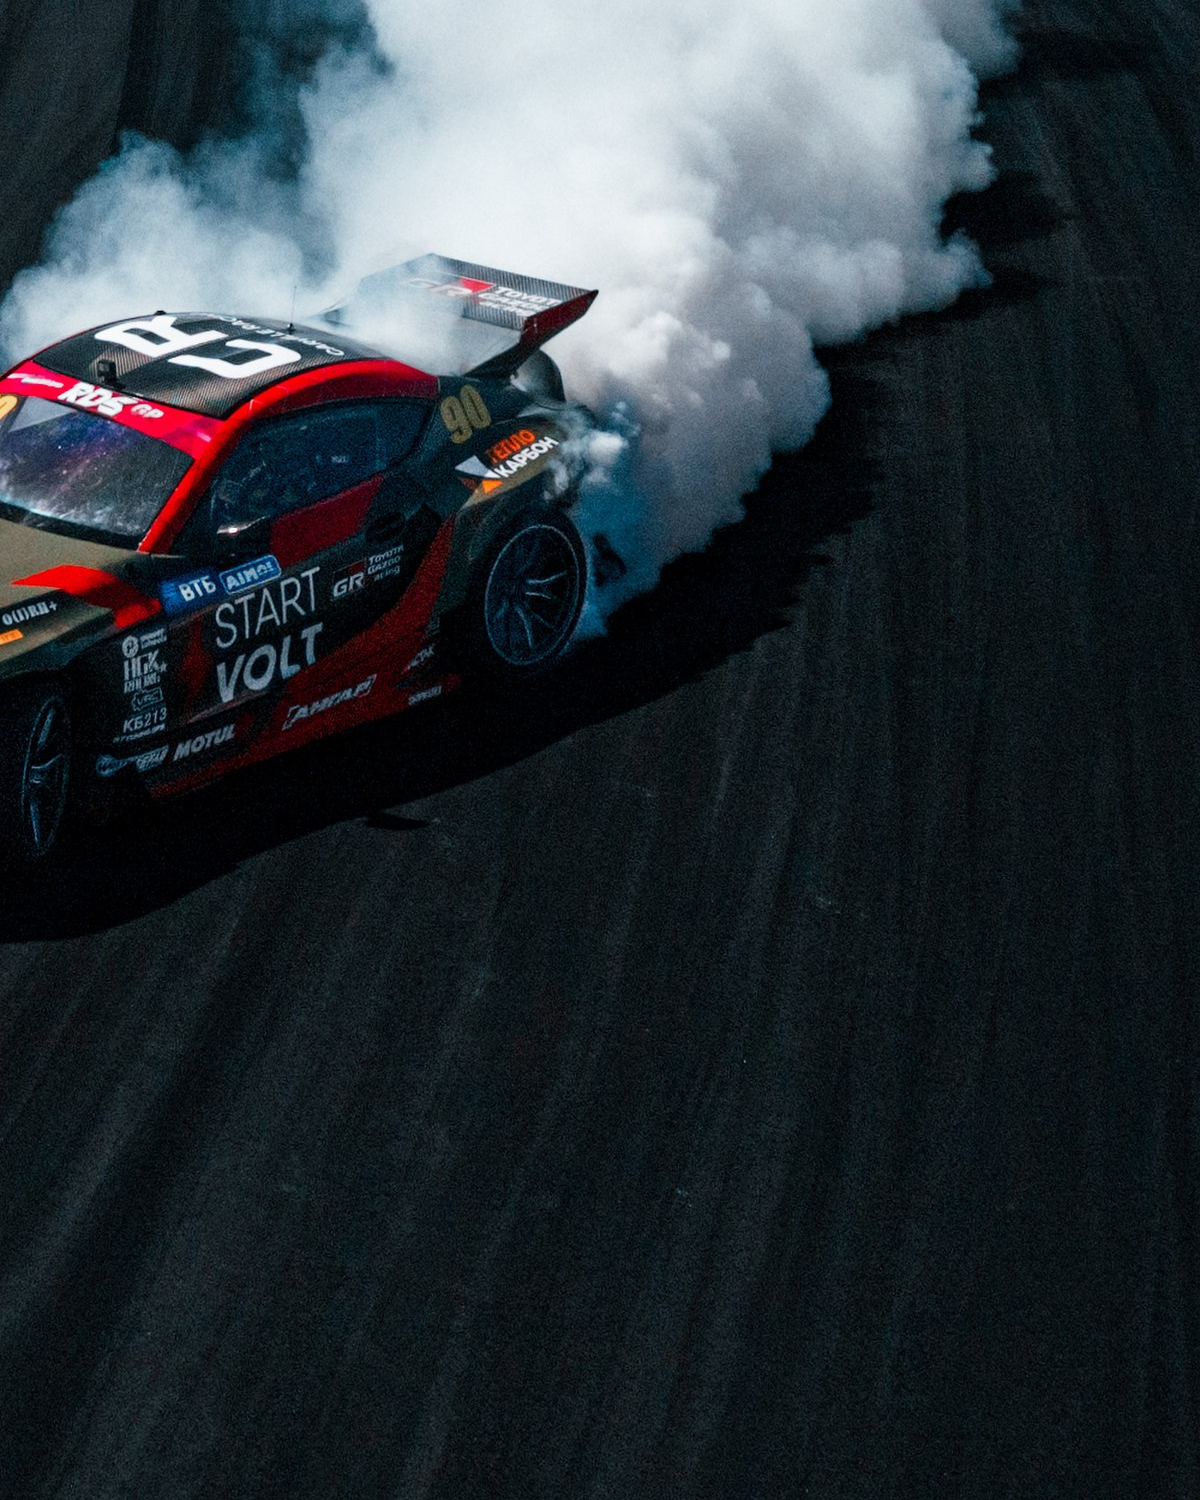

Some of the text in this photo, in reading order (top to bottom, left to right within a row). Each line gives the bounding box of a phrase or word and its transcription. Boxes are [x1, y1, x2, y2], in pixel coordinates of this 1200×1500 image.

[58, 382, 139, 417] RDS
[440, 384, 492, 444] 90
[495, 436, 559, 478] КАРБОН
[178, 574, 216, 601] ВТБ
[333, 572, 365, 597] GR
[215, 566, 320, 649] START
[216, 622, 323, 702] VOLT
[173, 724, 236, 761] MOTUL
